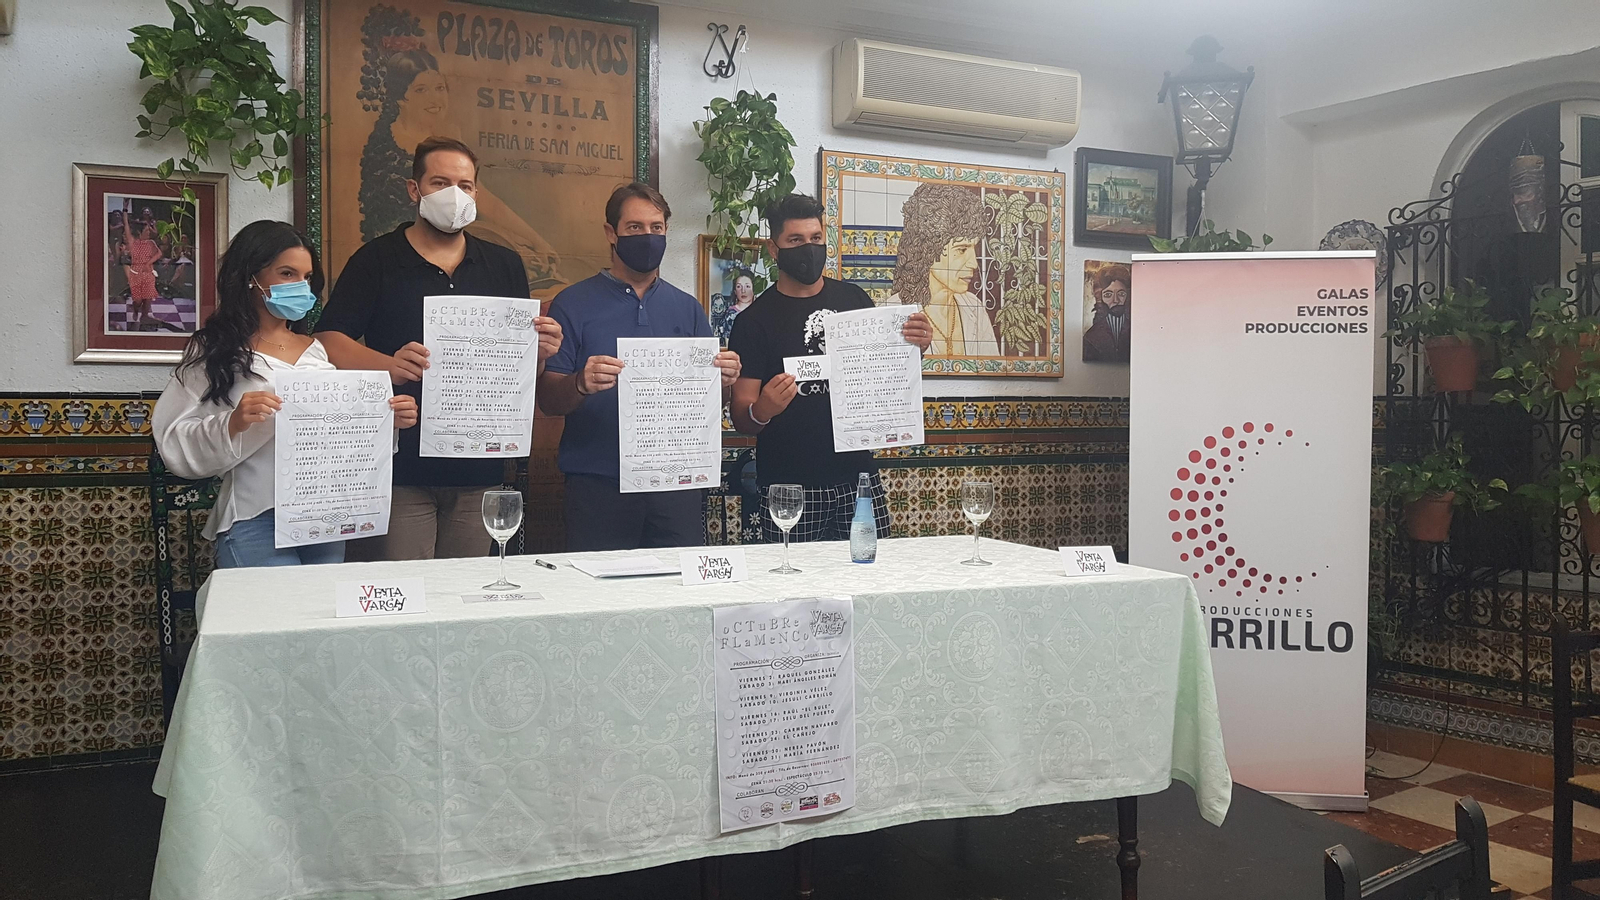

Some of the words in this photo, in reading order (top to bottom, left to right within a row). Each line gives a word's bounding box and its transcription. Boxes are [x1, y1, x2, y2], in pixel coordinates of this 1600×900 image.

[437, 11, 520, 66] PLAZA
[525, 30, 543, 57] DE
[548, 26, 628, 76] TOROS
[525, 74, 562, 86] DE
[476, 87, 609, 121] SEVILLA
[478, 131, 520, 151] FERIA
[524, 137, 535, 151] DE
[539, 137, 569, 155] SAN
[576, 141, 624, 161] MIGUEL
[1317, 288, 1369, 300] GALAS
[1297, 305, 1369, 317] EVENTOS
[1245, 322, 1368, 334] PRODUCCIONES
[698, 556, 731, 567] VENTA
[1075, 551, 1103, 561] VENTA
[360, 585, 404, 598] VENTA
[1200, 605, 1313, 618] RODUCCIONES
[1211, 617, 1354, 653] RRILLO
[733, 658, 769, 667] PROGRAMACIÓN
[739, 676, 766, 684] VIERNES
[804, 667, 835, 675] GONZÁLEZ
[794, 675, 816, 683] ÁNGELES
[739, 694, 767, 702] VIERNES
[779, 689, 807, 697] VIRGINIA
[805, 691, 833, 700] CARRILLO
[740, 713, 767, 721] VIERNES
[813, 709, 835, 717] PUERTO
[741, 731, 768, 740] VIERNES
[784, 725, 809, 734] CARMEN
[811, 720, 839, 729] NAVARRO
[742, 749, 768, 758] VIERNES
[807, 740, 826, 748] PAVÓN
[784, 749, 803, 758] MARÍA
[806, 744, 840, 754] FERNÁNDEZ
